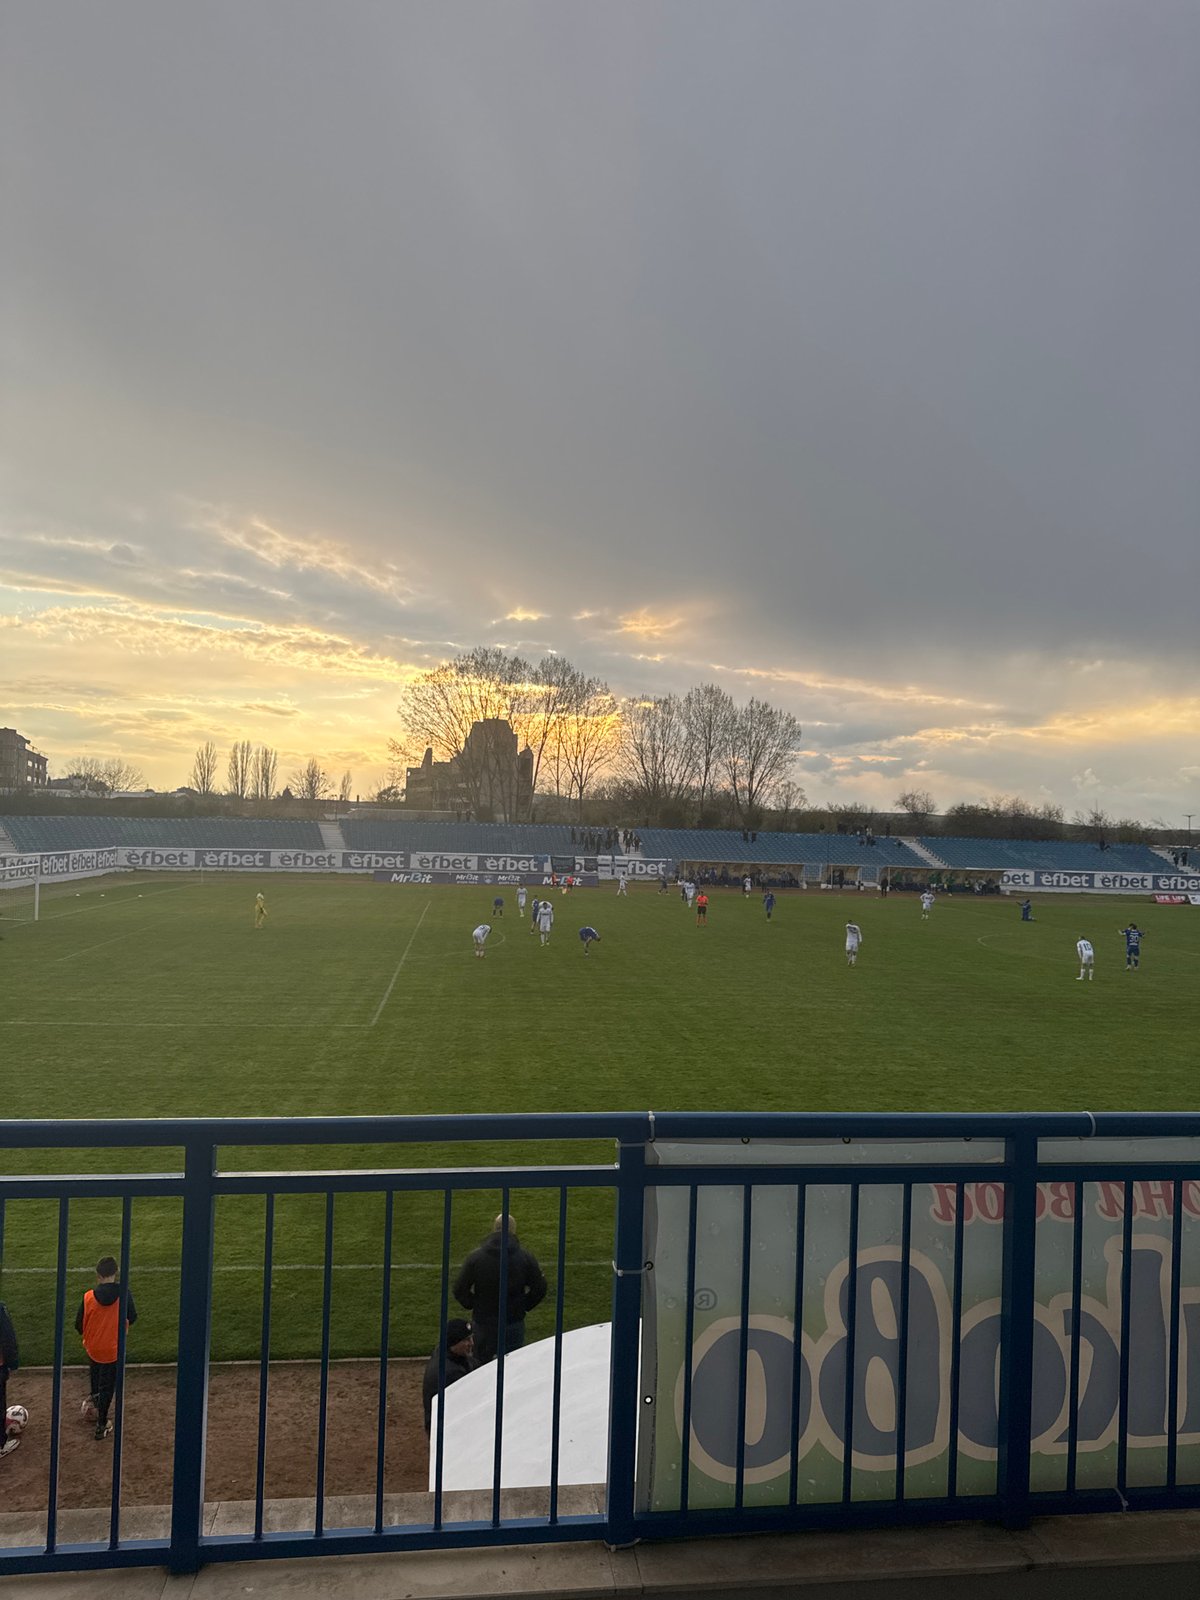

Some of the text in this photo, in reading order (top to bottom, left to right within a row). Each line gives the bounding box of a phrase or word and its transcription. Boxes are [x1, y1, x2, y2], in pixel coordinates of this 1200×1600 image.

[42, 854, 68, 874] efbet
[71, 852, 96, 871] efbet
[126, 851, 188, 866] efbet
[203, 852, 264, 866] efbet
[279, 852, 336, 867] efbet
[349, 853, 404, 868] efbet
[420, 855, 471, 869] efbet
[485, 856, 538, 871] efbet
[627, 860, 667, 875] fbet
[390, 872, 433, 884] MrBit
[1001, 872, 1030, 884] bet
[1041, 872, 1089, 887] efbet
[1101, 874, 1148, 889] efbet
[1158, 875, 1200, 890] efbe
